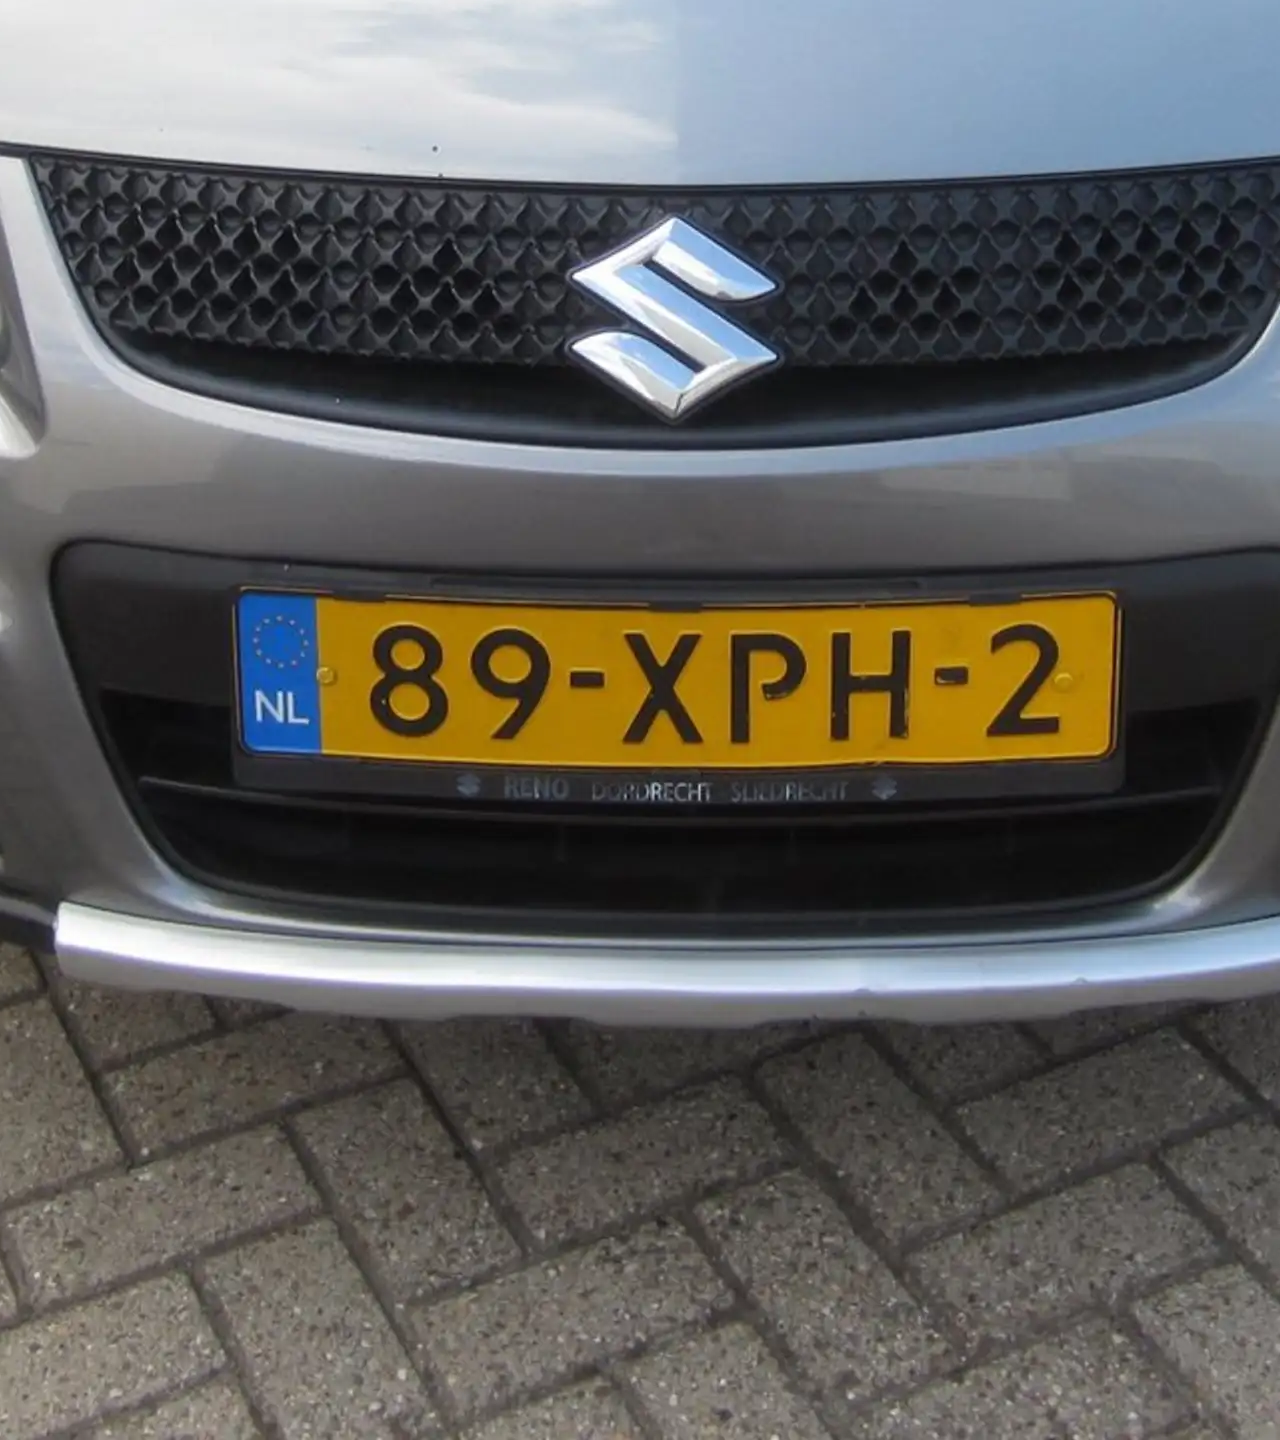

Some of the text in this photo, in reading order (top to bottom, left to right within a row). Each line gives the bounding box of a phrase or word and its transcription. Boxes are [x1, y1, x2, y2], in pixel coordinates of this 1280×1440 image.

[368, 622, 1061, 745] 89-XPH-2
[254, 688, 310, 725] NL
[591, 780, 712, 803] DORDRECHT
